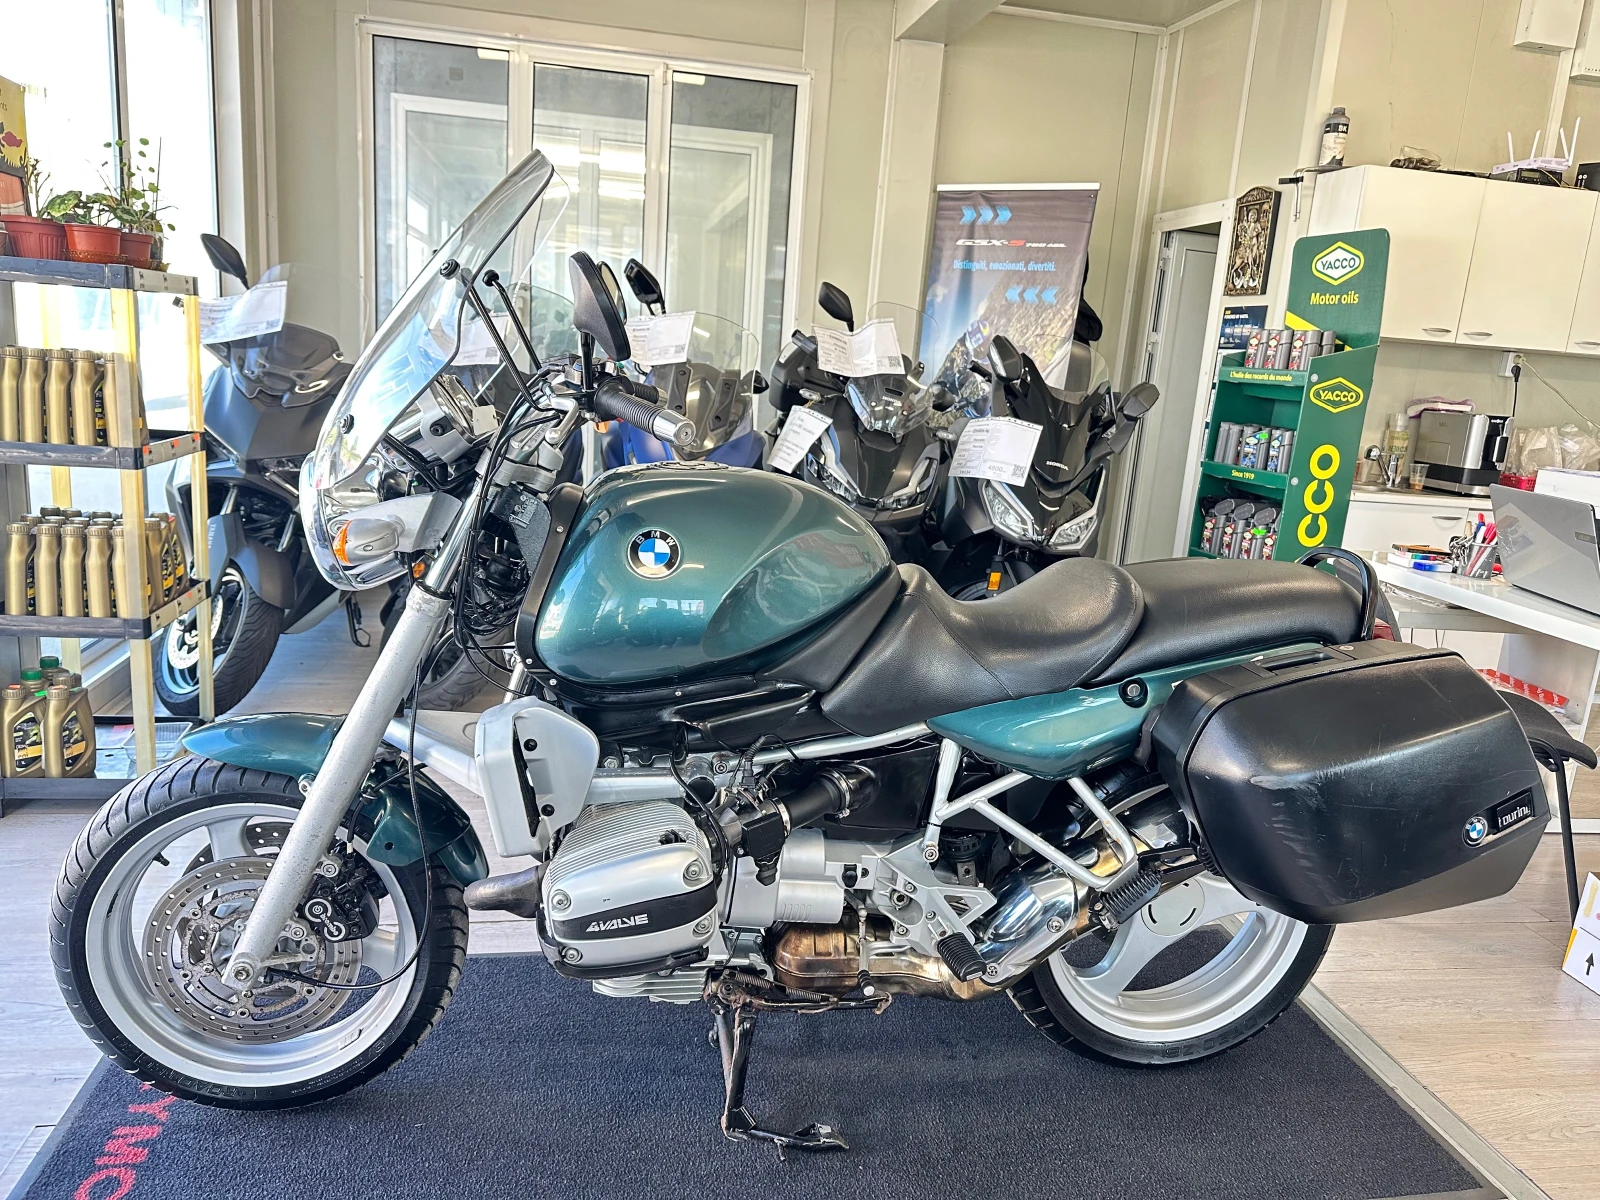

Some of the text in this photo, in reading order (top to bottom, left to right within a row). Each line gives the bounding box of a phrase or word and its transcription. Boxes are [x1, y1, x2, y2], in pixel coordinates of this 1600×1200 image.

[953, 260, 1056, 272] Distinguiti, emozionati, divertiti.
[1321, 257, 1356, 271] YACCO
[1310, 291, 1359, 305] Motor oils
[1319, 390, 1356, 402] YACCO
[1046, 461, 1068, 470] HONDA
[1231, 469, 1243, 478] Since
[1294, 444, 1340, 564] CCO
[635, 531, 676, 546] BMW
[74, 1082, 177, 1200] YMC
